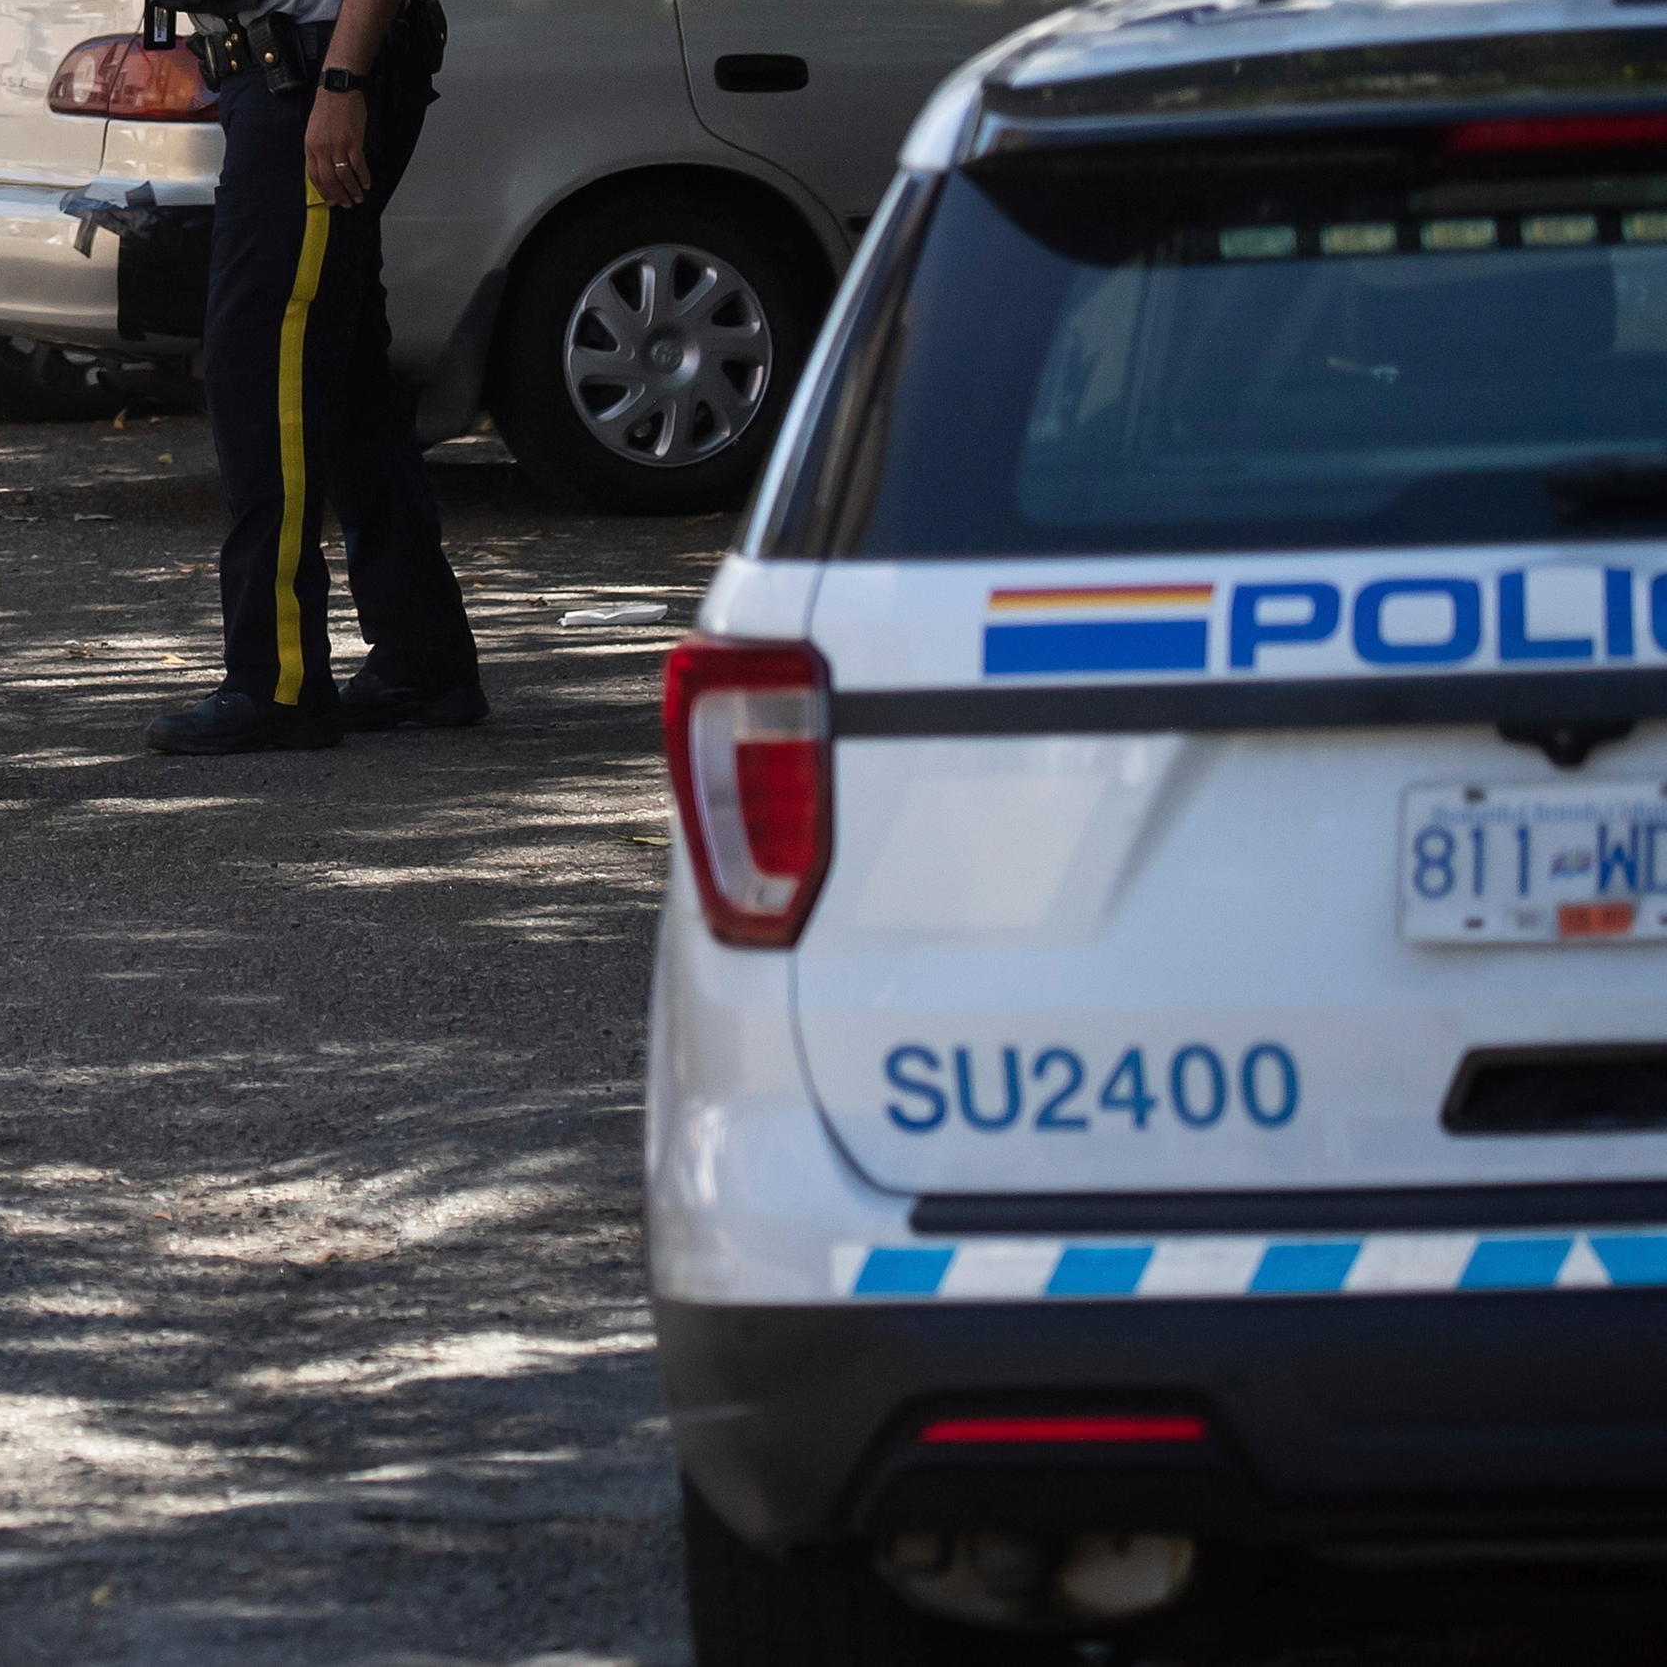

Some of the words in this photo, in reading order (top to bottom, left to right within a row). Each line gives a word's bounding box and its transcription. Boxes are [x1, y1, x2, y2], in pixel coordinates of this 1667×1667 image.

[1228, 566, 1667, 671] POLI
[1412, 824, 1531, 901] 811
[882, 1042, 1303, 1135] SU2400
